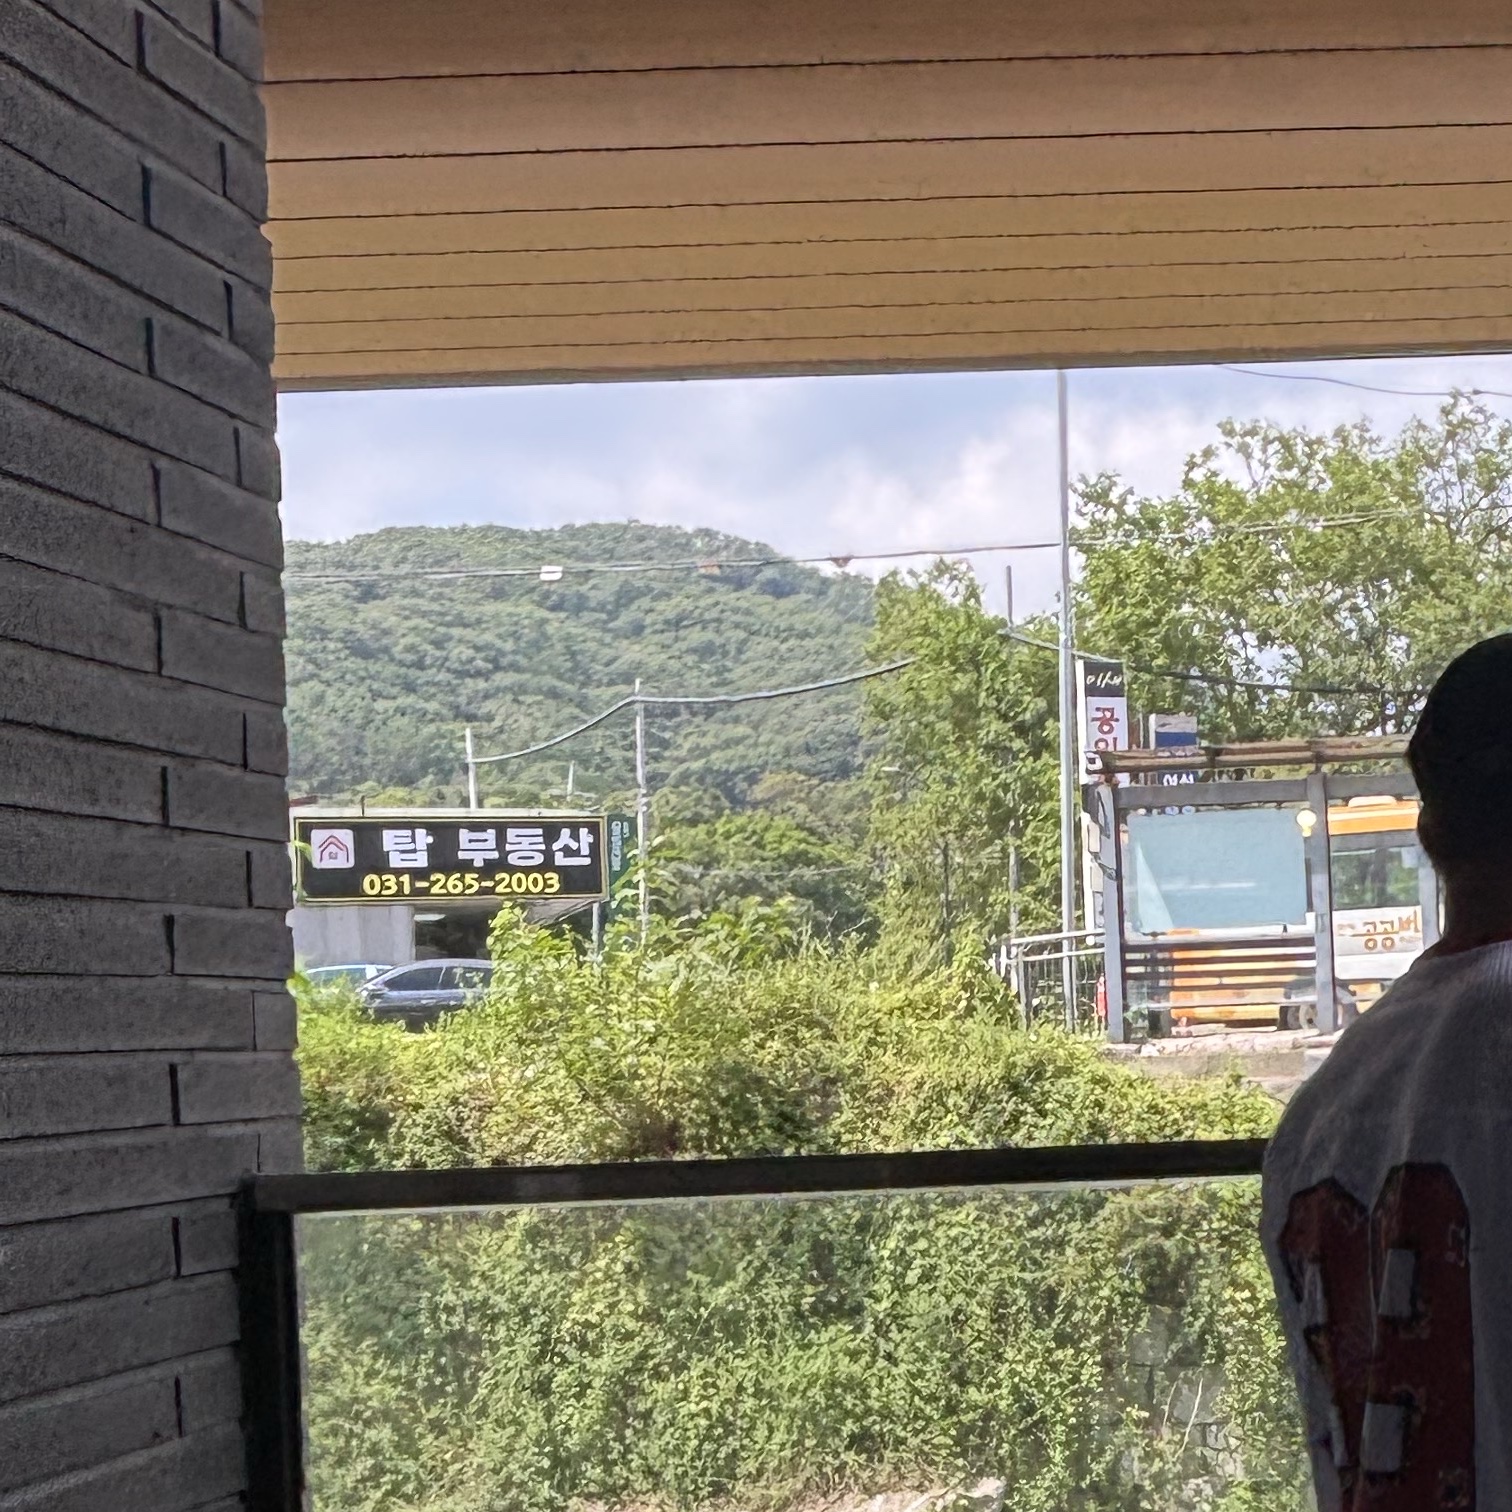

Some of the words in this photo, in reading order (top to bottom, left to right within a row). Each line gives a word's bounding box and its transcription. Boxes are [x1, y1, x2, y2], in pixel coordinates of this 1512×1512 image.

[382, 828, 434, 869] 탑
[457, 827, 594, 867] 부동산
[362, 871, 562, 897] 031-265-2003
